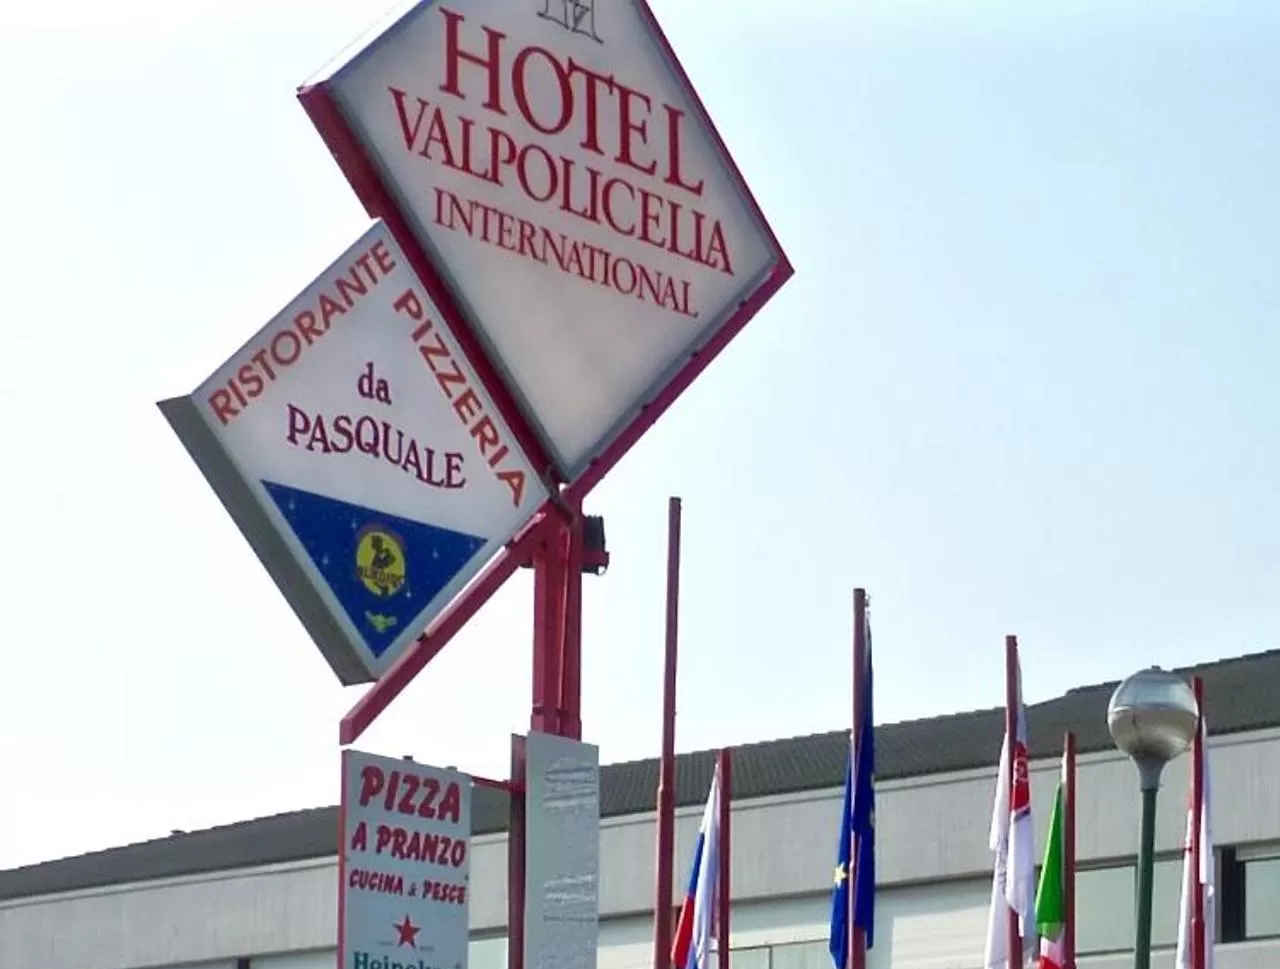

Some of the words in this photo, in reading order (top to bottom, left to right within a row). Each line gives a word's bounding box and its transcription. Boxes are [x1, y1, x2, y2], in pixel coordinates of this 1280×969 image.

[438, 6, 704, 196] HOTEL
[433, 187, 699, 319] INTERNATIONAL
[207, 240, 397, 426] RISTORANTE
[358, 361, 392, 405] da
[393, 288, 526, 509] PIZZERIA
[286, 404, 466, 490] PASQUALE
[359, 765, 461, 824] PIZZA
[349, 868, 404, 897] CUCINA
[422, 879, 465, 905] PESCE
[352, 821, 367, 851] A
[375, 825, 466, 868] PRANZO
